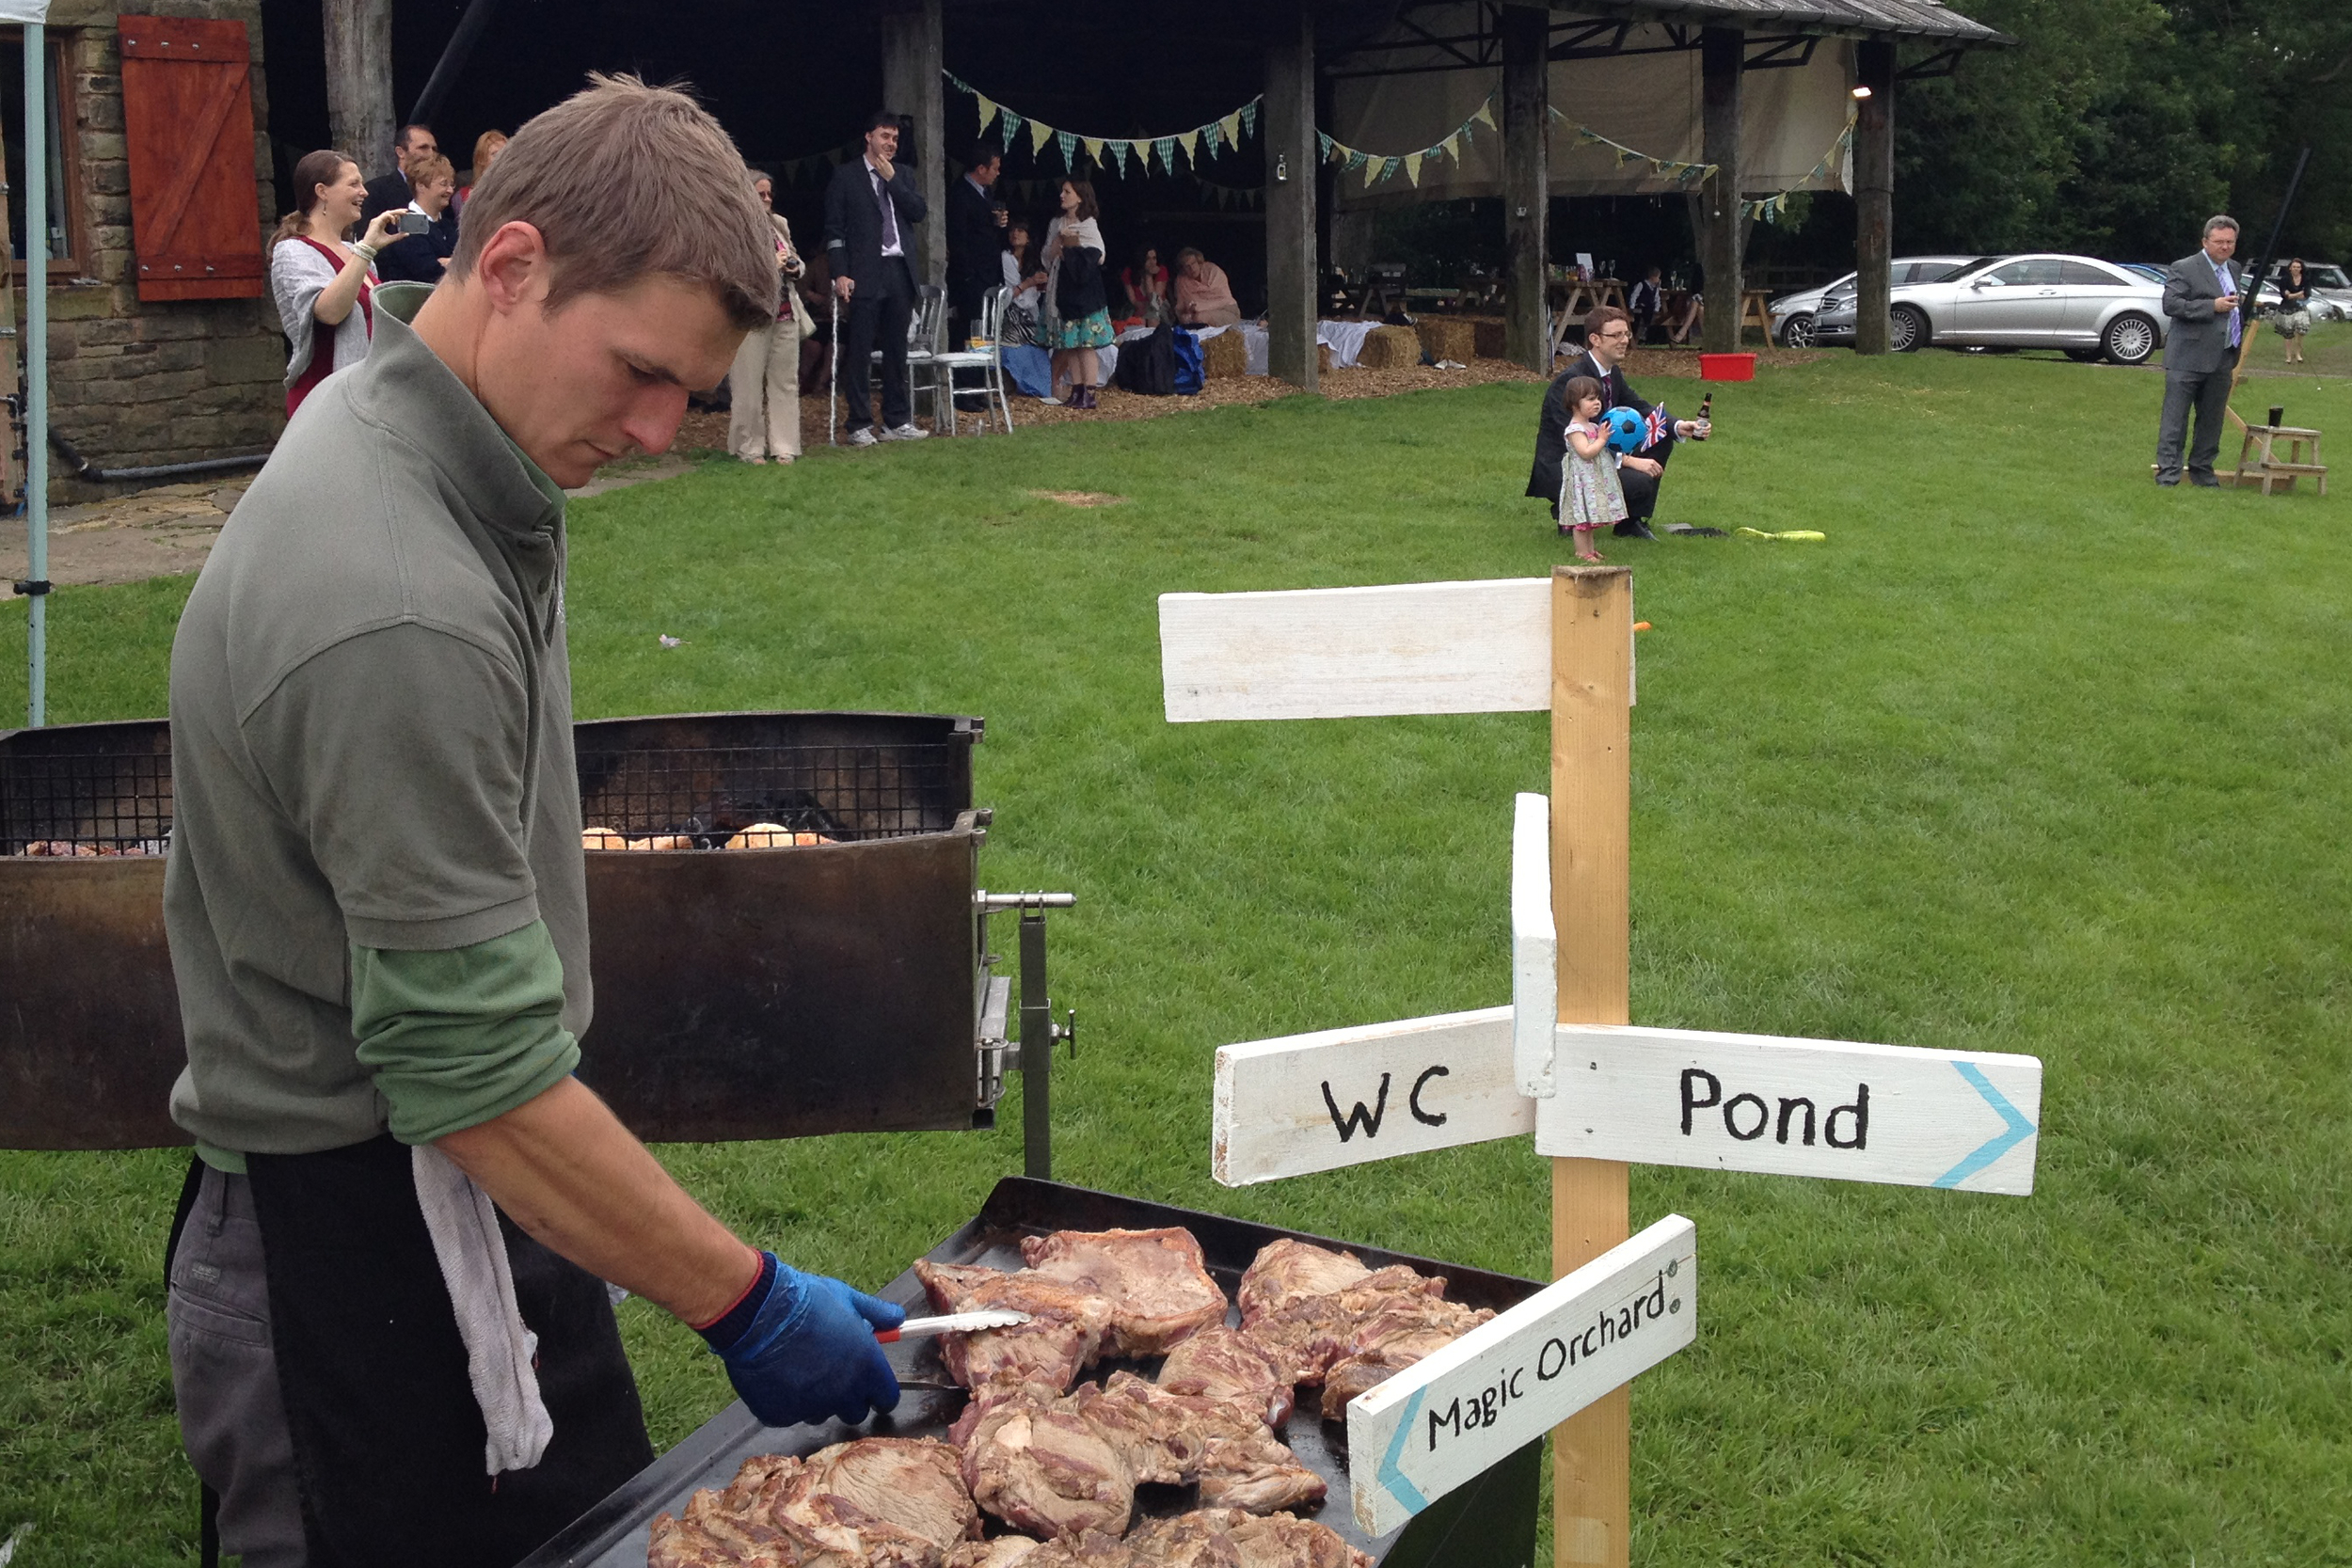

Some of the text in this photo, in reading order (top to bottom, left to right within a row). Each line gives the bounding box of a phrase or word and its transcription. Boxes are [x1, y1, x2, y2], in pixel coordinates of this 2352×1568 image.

[1321, 1065, 1450, 1143] WC
[1680, 1069, 1870, 1150] Pond
[1429, 1270, 1665, 1452] Magic Orchard
